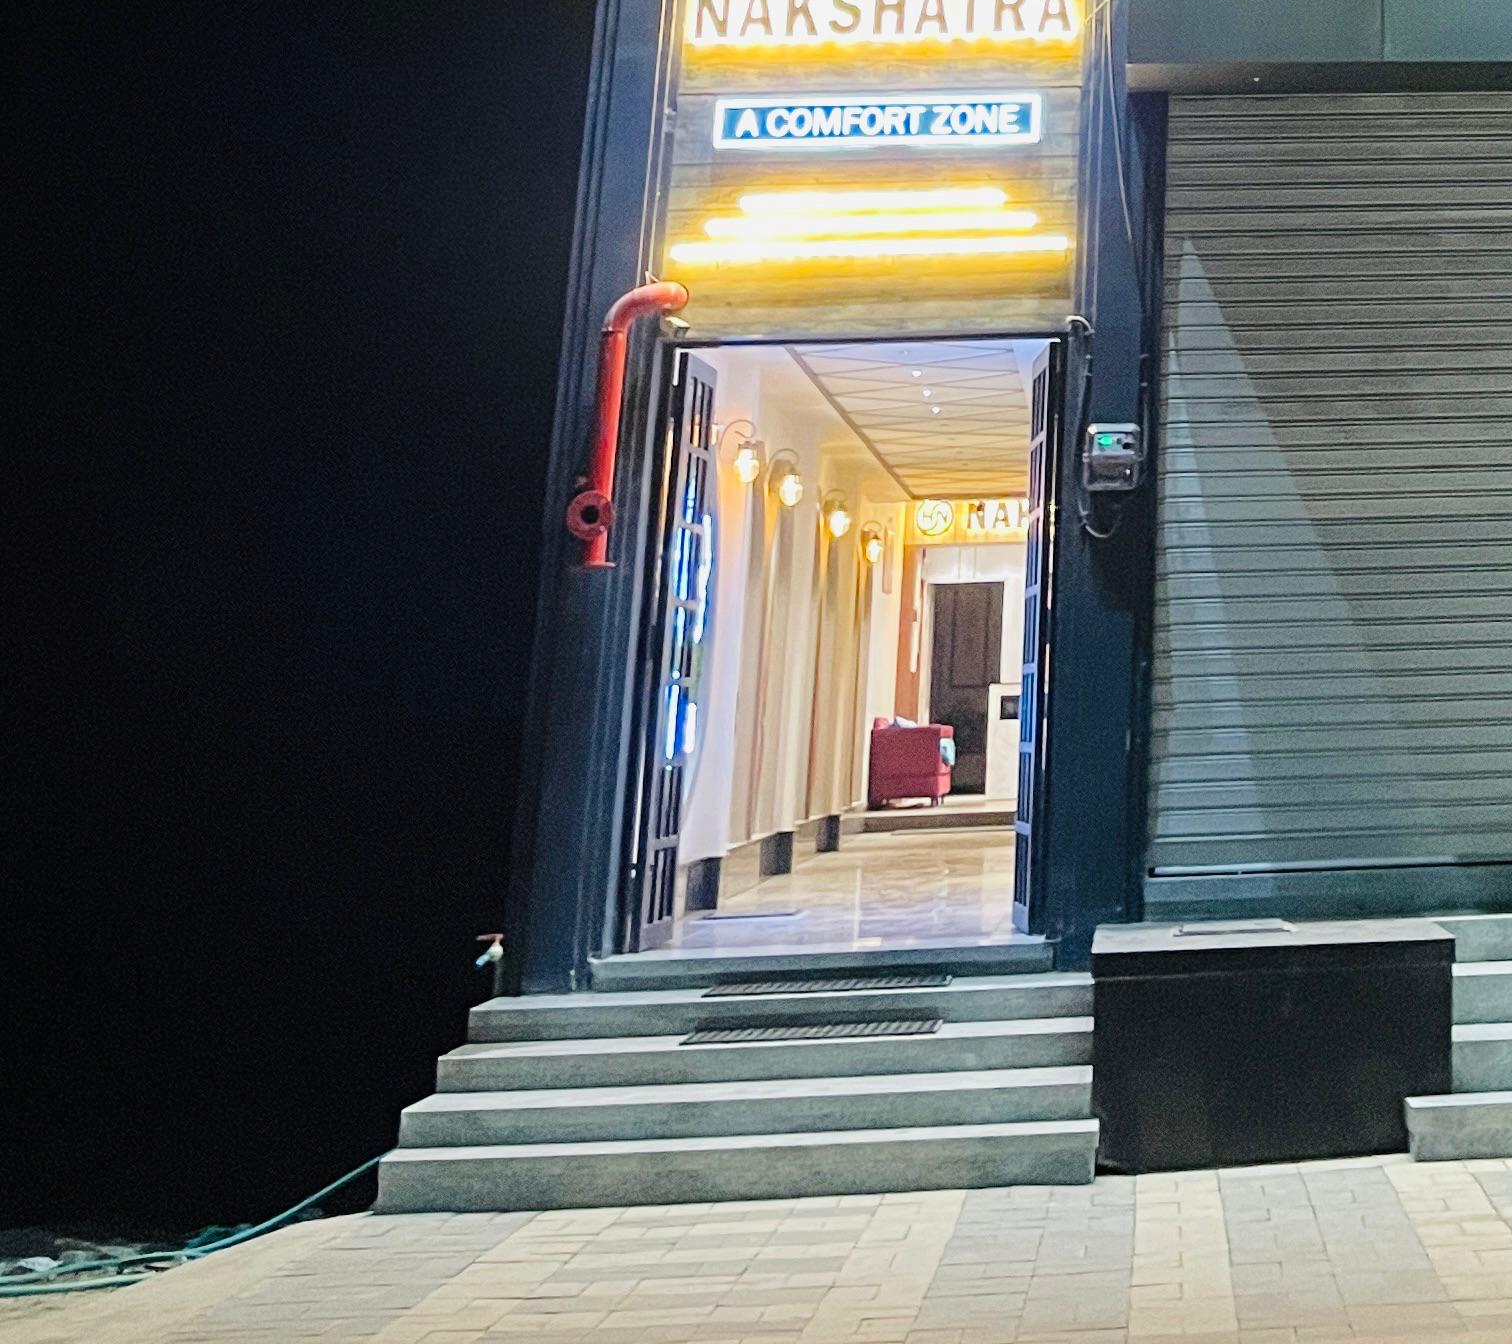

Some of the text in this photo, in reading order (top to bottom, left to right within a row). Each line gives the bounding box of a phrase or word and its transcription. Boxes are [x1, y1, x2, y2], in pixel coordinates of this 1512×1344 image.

[734, 103, 1021, 139] A COMFORT ZONE
